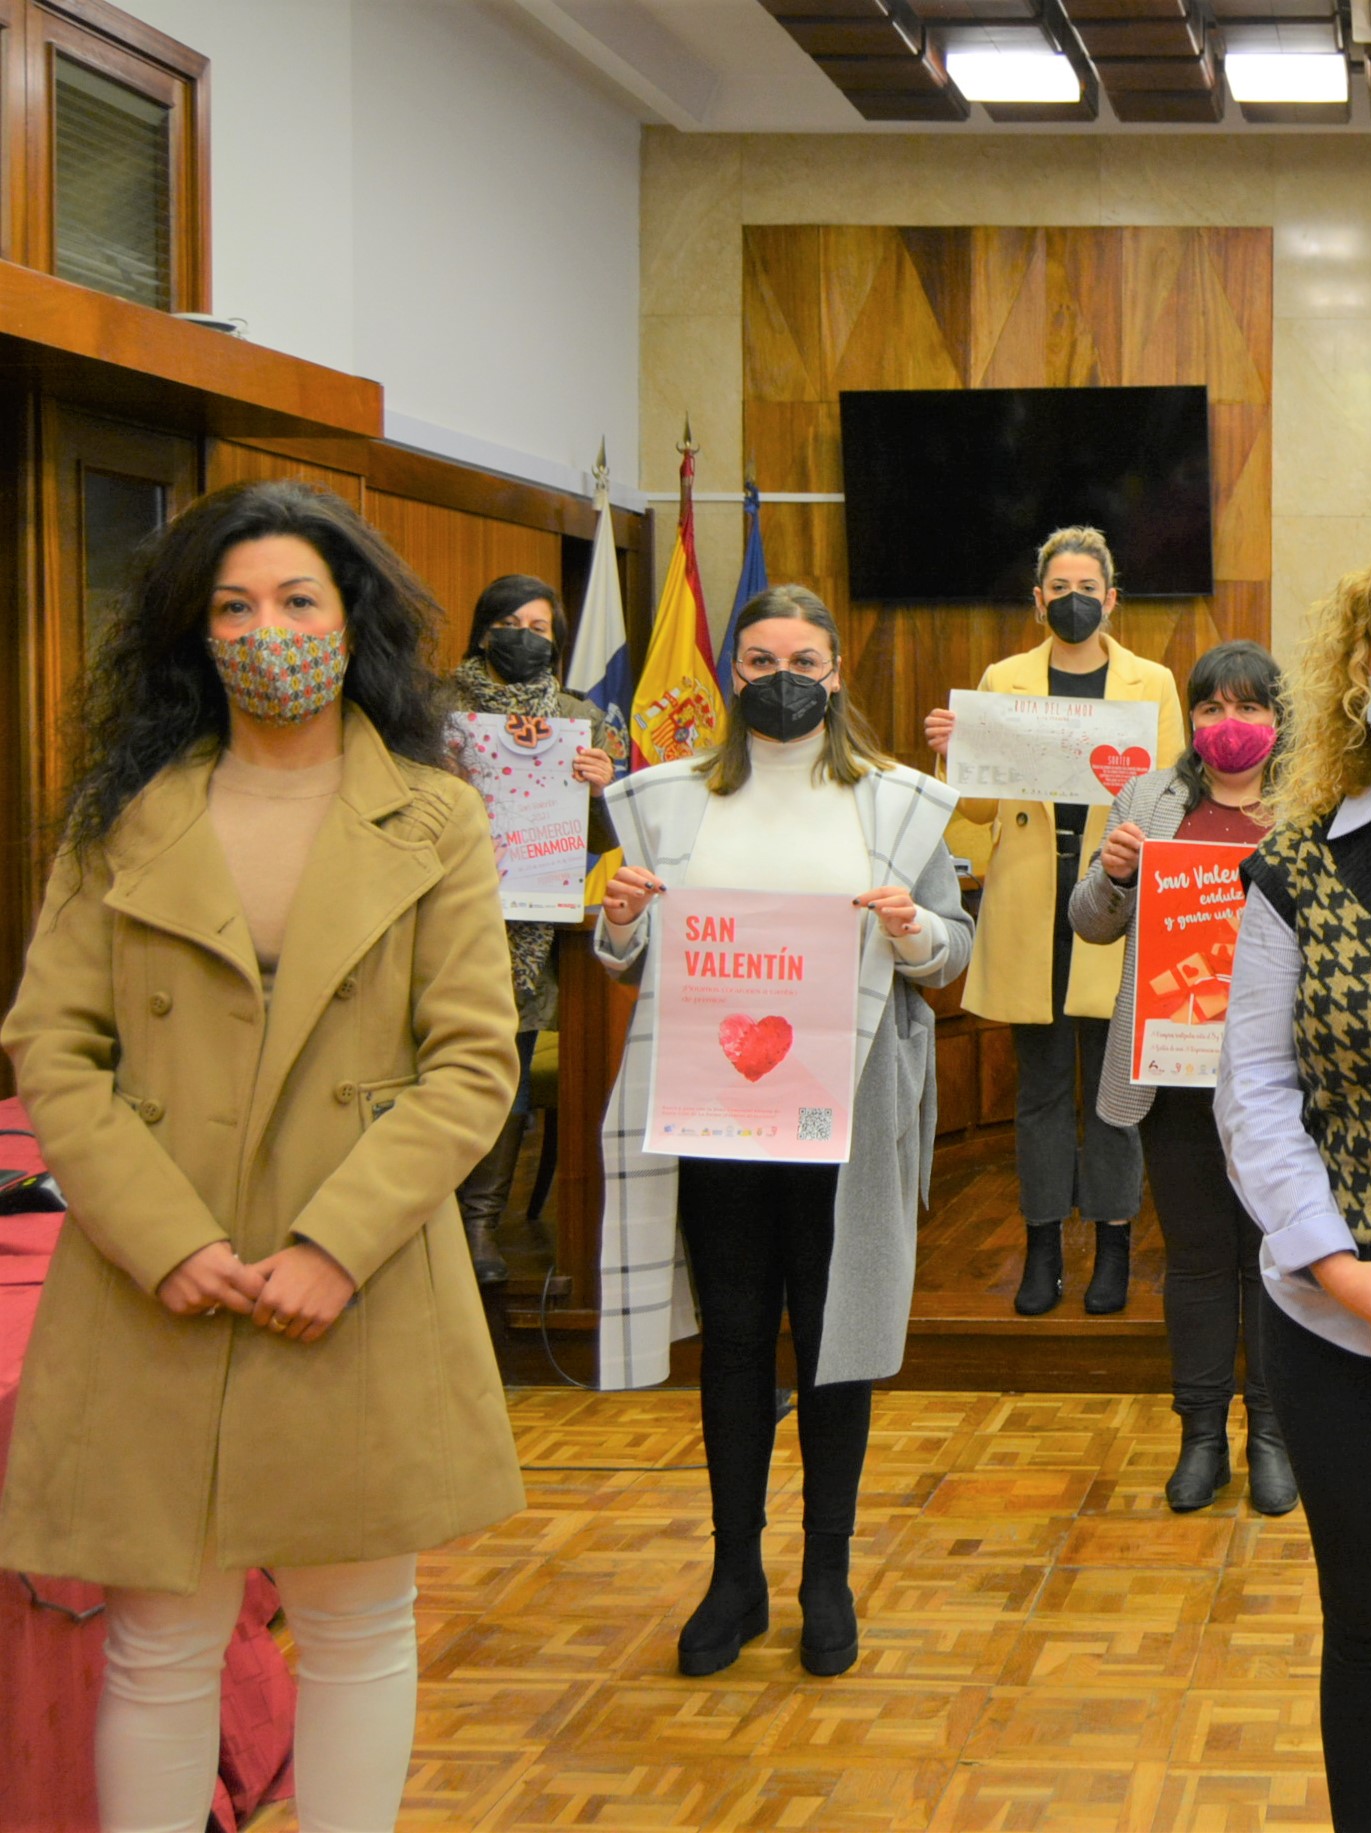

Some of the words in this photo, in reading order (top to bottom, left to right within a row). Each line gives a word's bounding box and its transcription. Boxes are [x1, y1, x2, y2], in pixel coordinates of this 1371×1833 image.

[1015, 700, 1038, 713] RUTA
[1045, 702, 1060, 715] DEL
[1067, 703, 1093, 717] AMOR
[1154, 870, 1190, 893] San
[686, 915, 735, 943] SAN
[1164, 917, 1175, 931] y
[1177, 912, 1212, 930] gana
[1214, 908, 1233, 920] un
[684, 946, 804, 981] VALENTÍN
